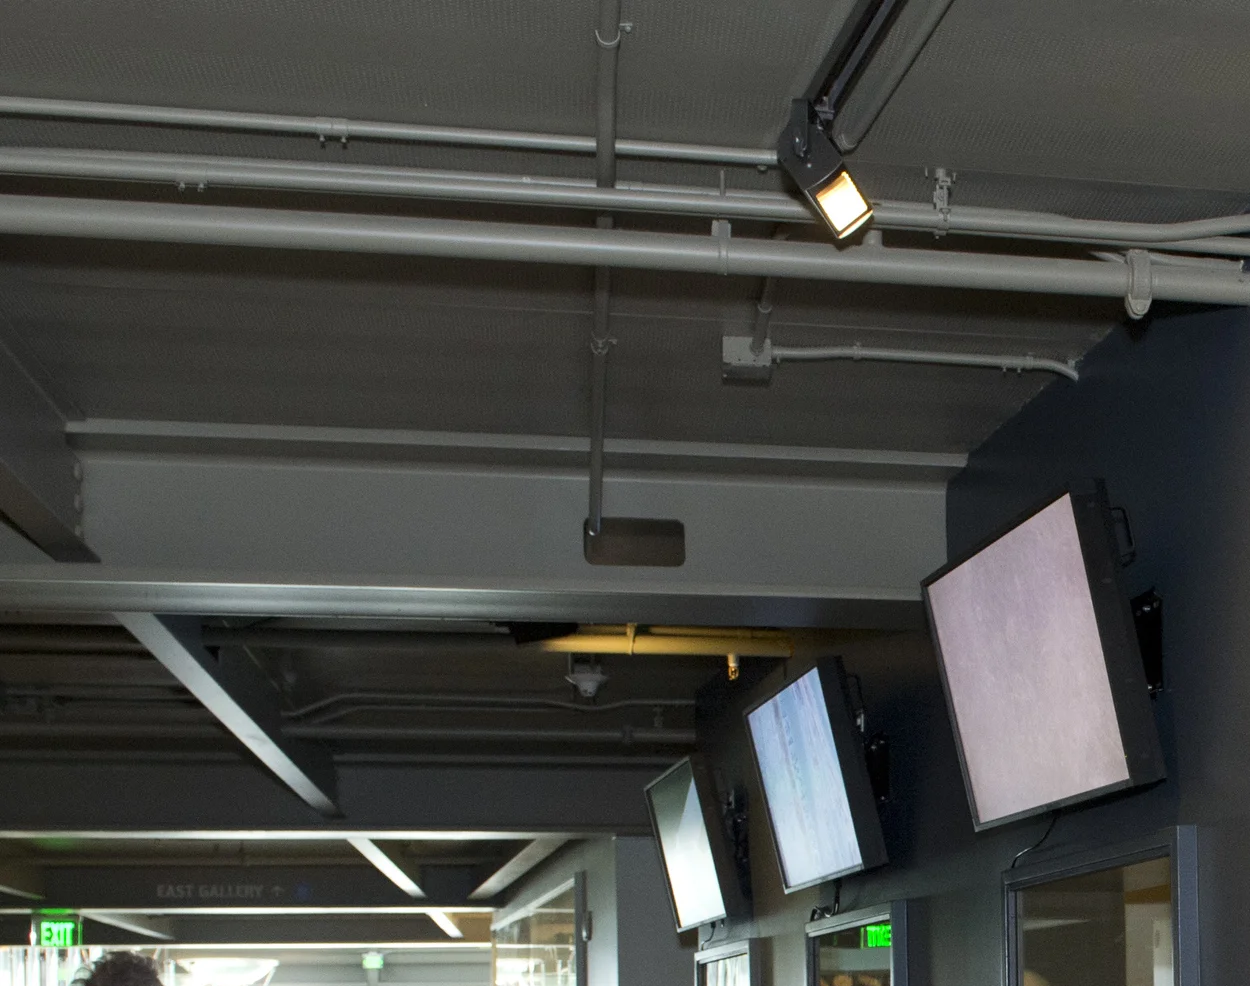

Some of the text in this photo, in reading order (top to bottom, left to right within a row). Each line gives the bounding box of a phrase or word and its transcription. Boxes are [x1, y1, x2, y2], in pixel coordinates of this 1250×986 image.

[157, 884, 264, 898] EAST GALLERY
[40, 922, 75, 946] EXIT
